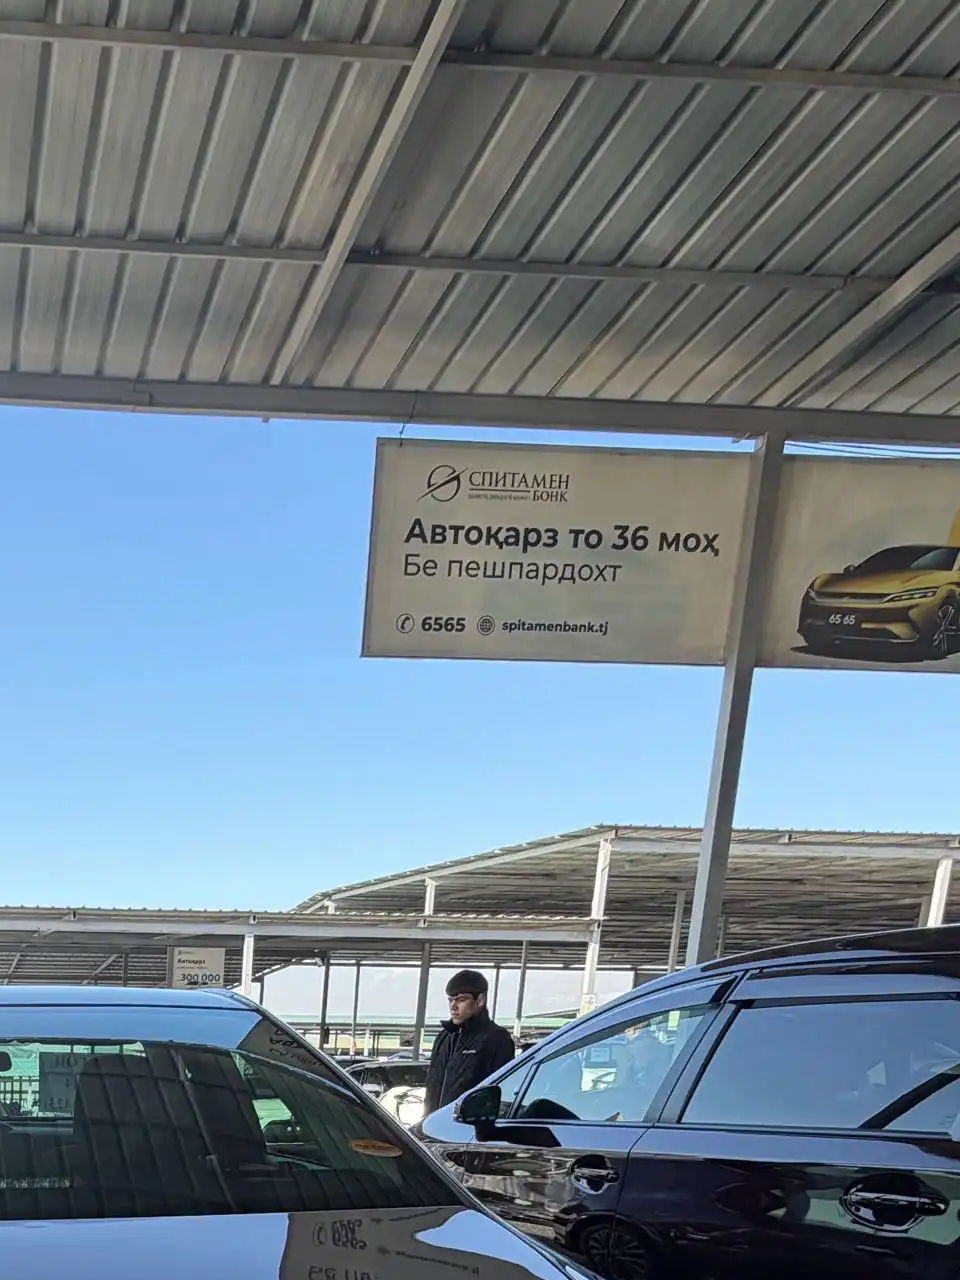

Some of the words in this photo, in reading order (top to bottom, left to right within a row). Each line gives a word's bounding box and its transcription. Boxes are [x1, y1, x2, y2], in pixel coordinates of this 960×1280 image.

[469, 471, 570, 490] СПИТАМЕН
[532, 490, 568, 503] БОНК
[404, 518, 559, 553] Автоқарз
[568, 528, 603, 550] то
[611, 525, 649, 551] 36
[403, 553, 438, 577] Бе
[447, 559, 623, 586] пешпардохт
[421, 616, 466, 633] 6565
[502, 619, 609, 637] spitamenbank.tj
